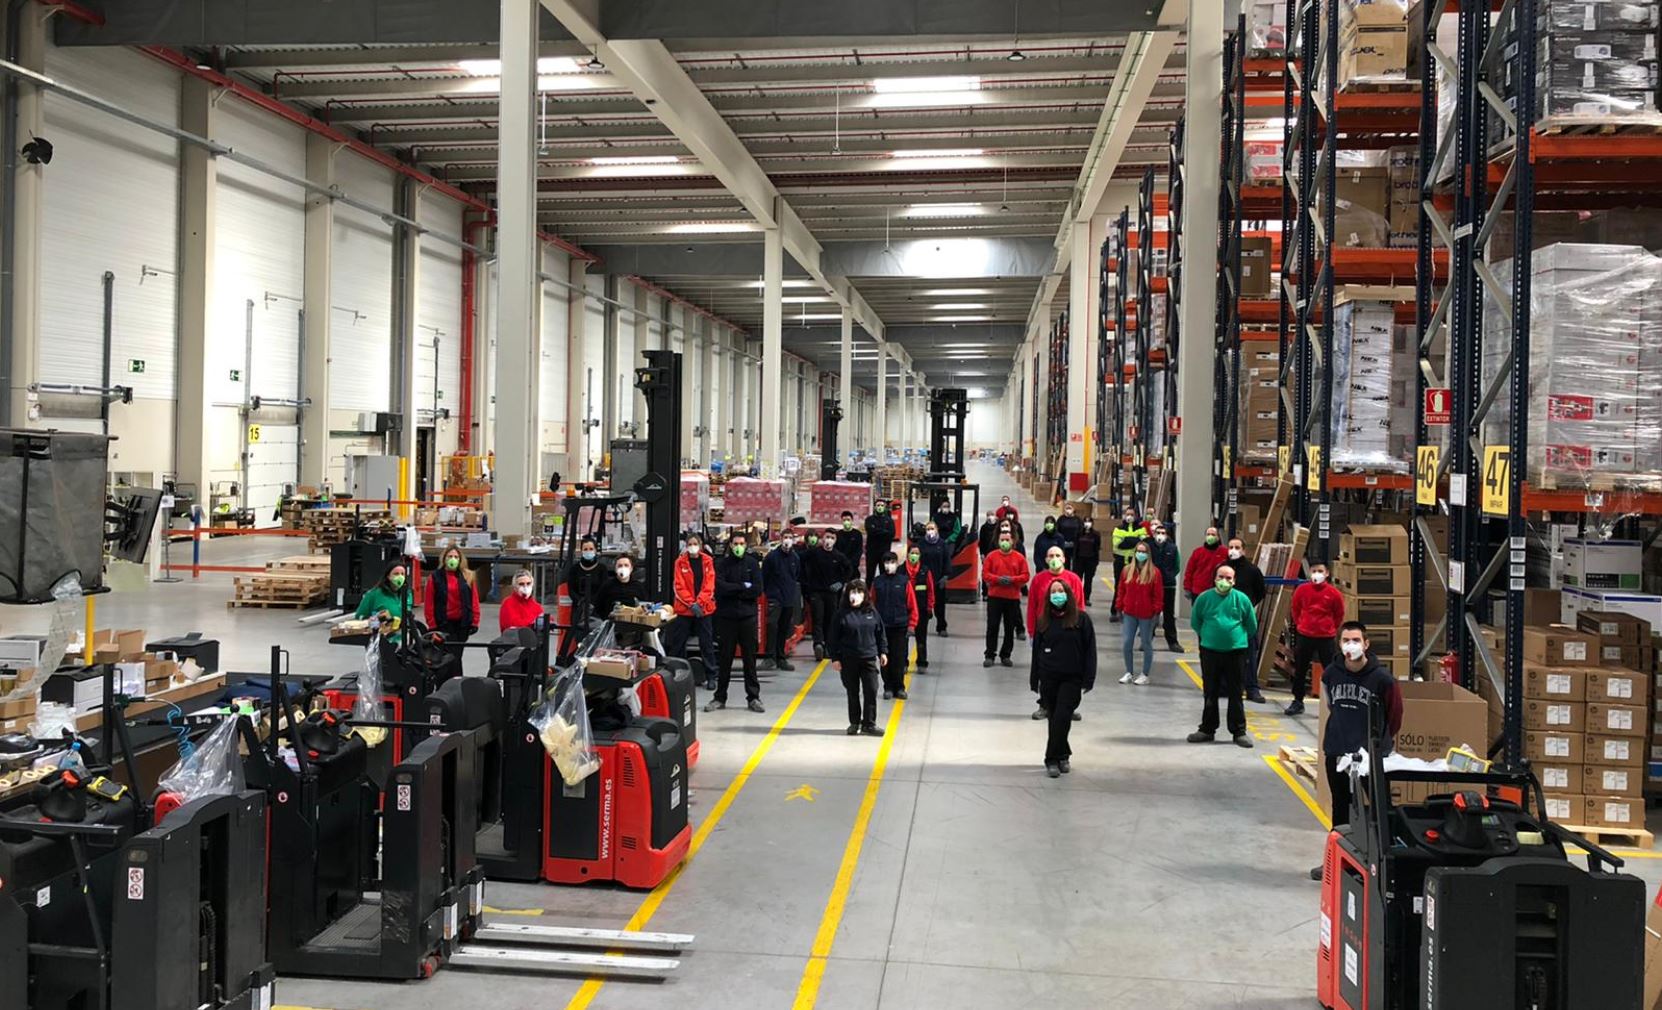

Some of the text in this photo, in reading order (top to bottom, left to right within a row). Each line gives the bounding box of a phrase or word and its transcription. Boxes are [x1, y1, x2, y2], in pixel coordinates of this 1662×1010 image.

[250, 427, 259, 440] 15
[1418, 450, 1435, 489] 46
[1486, 451, 1511, 495] 47
[1400, 732, 1425, 746] SÓLO
[602, 779, 612, 859] www.serma.es
